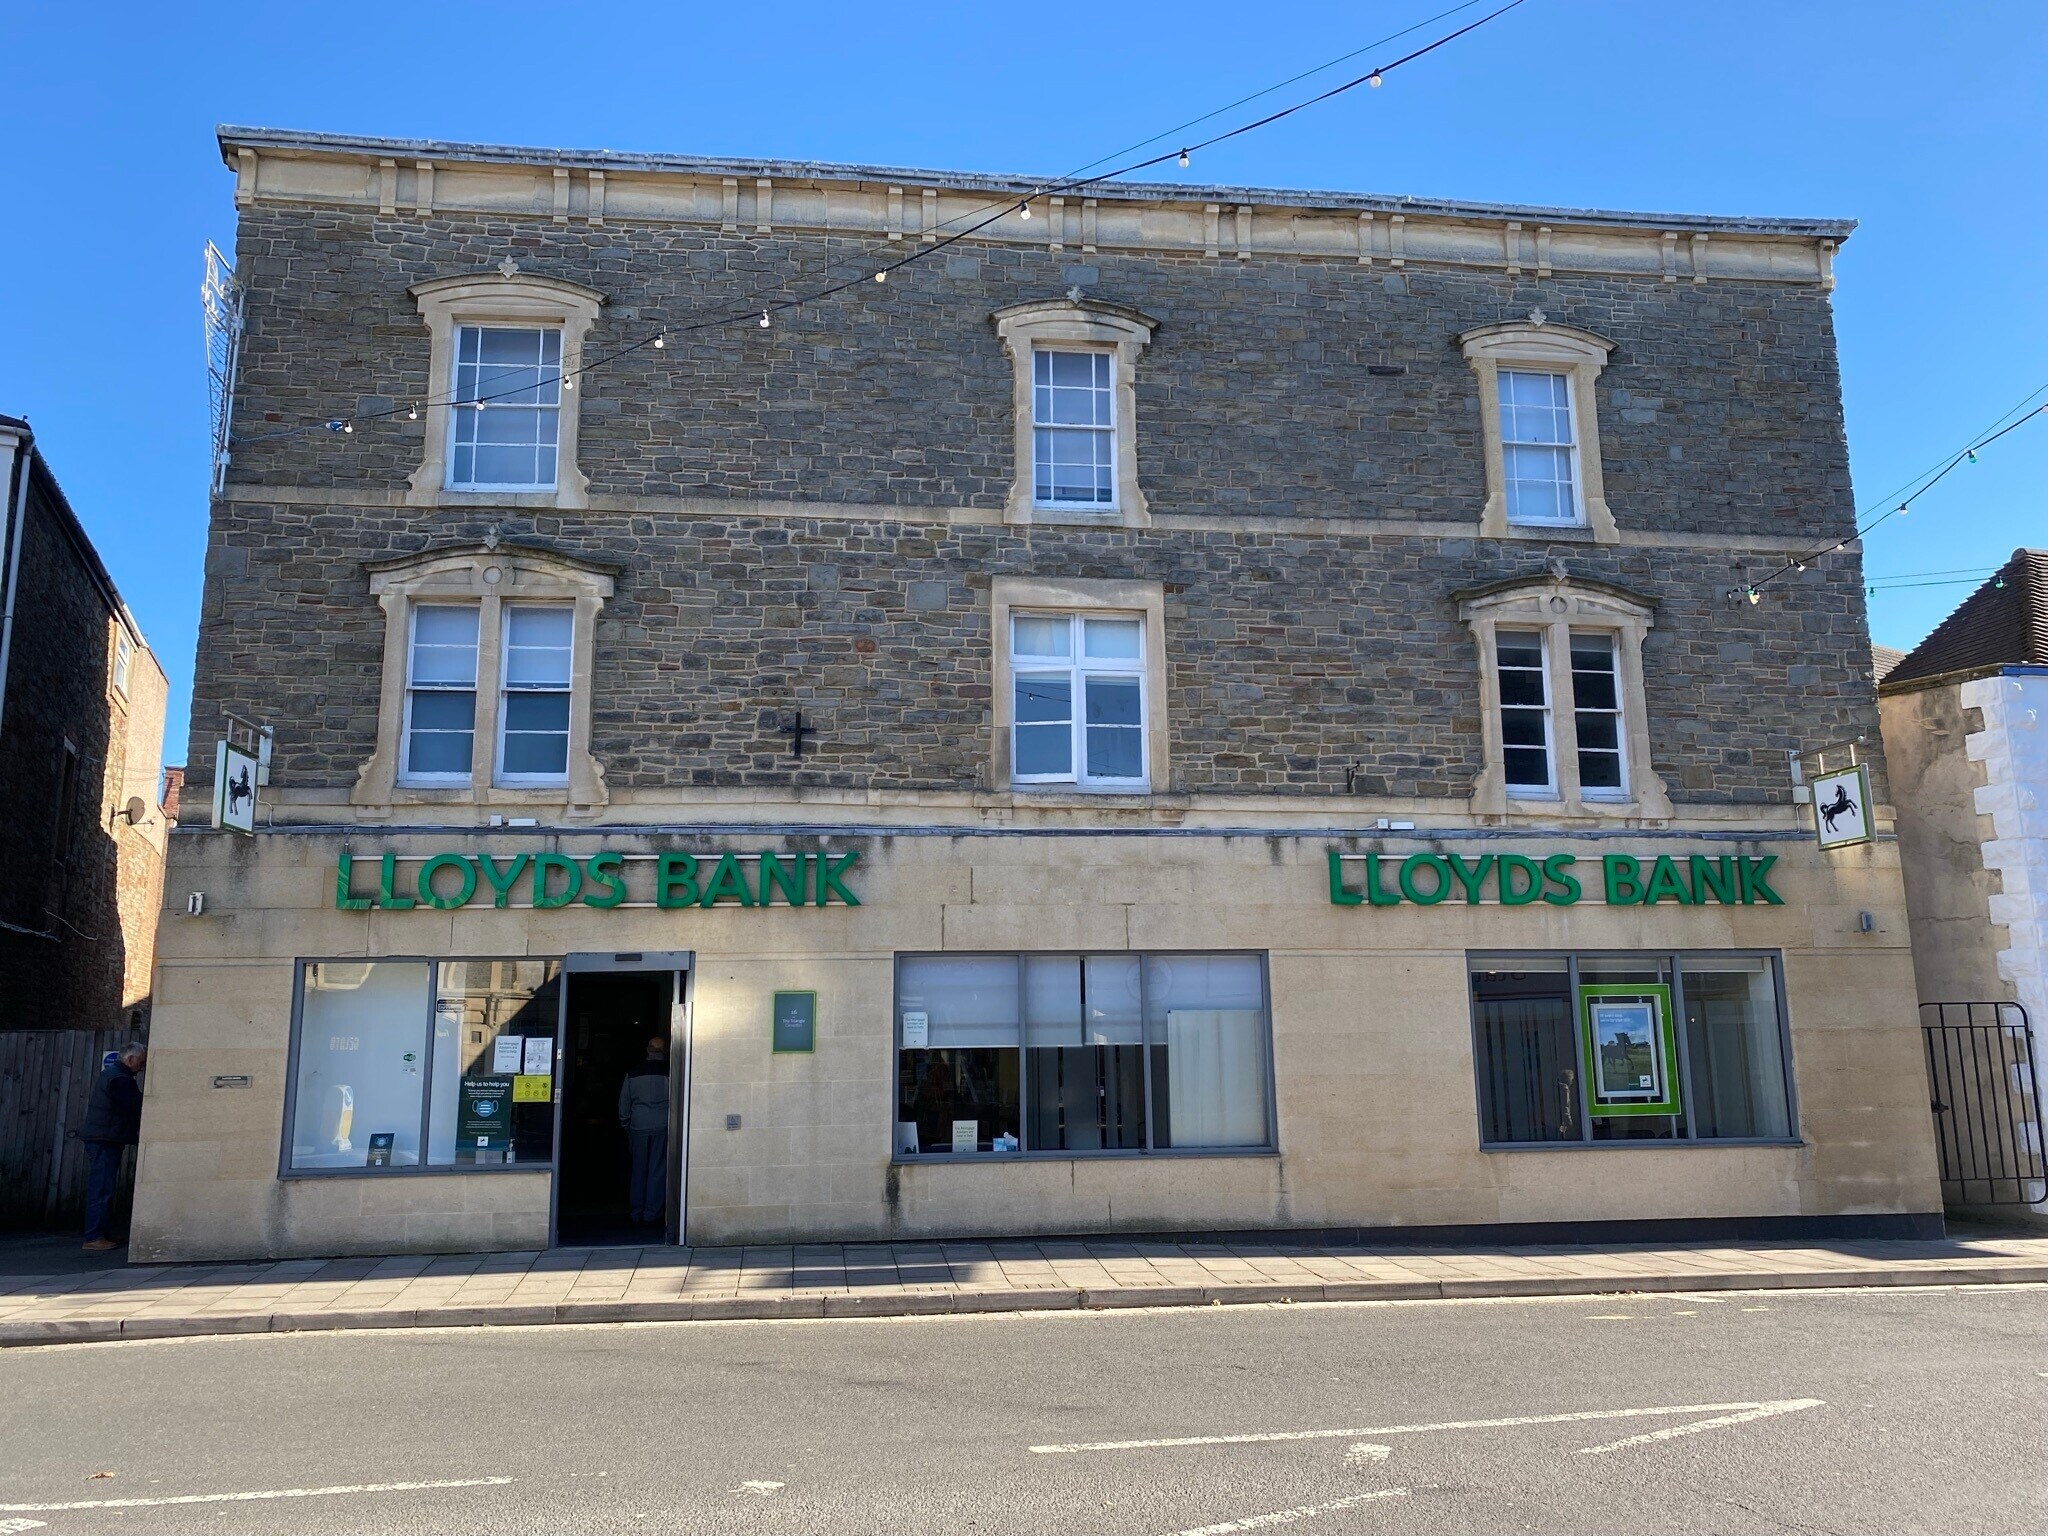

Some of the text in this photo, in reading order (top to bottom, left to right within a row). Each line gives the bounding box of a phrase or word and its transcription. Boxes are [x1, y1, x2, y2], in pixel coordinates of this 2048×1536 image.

[336, 852, 862, 910] LLOYDS BANK
[1328, 852, 1786, 906] LLOYDS BANK
